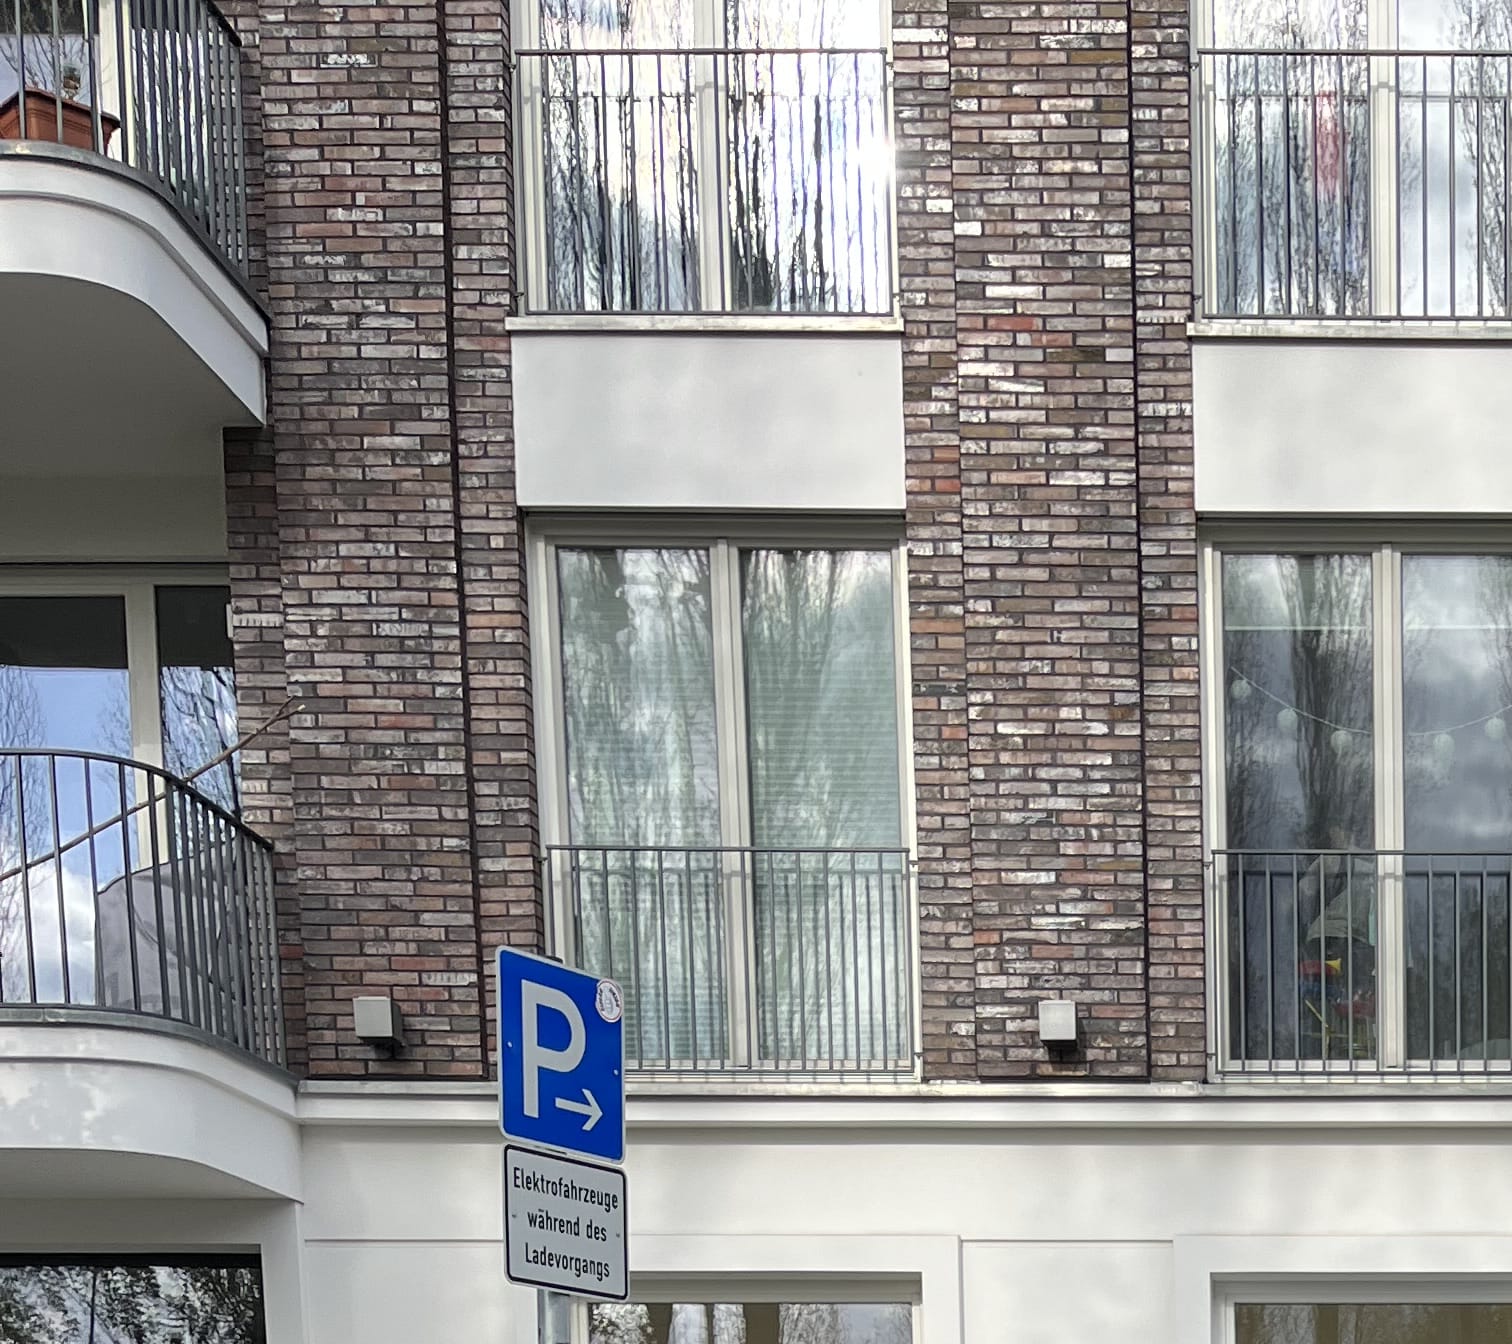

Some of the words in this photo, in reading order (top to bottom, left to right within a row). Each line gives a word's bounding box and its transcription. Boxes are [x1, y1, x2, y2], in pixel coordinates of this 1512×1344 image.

[521, 978, 586, 1119] P
[513, 1167, 619, 1213] Elektrofahrzeuge
[527, 1208, 580, 1238] während
[586, 1218, 608, 1243] des
[525, 1242, 610, 1280] Ladevorgangs
